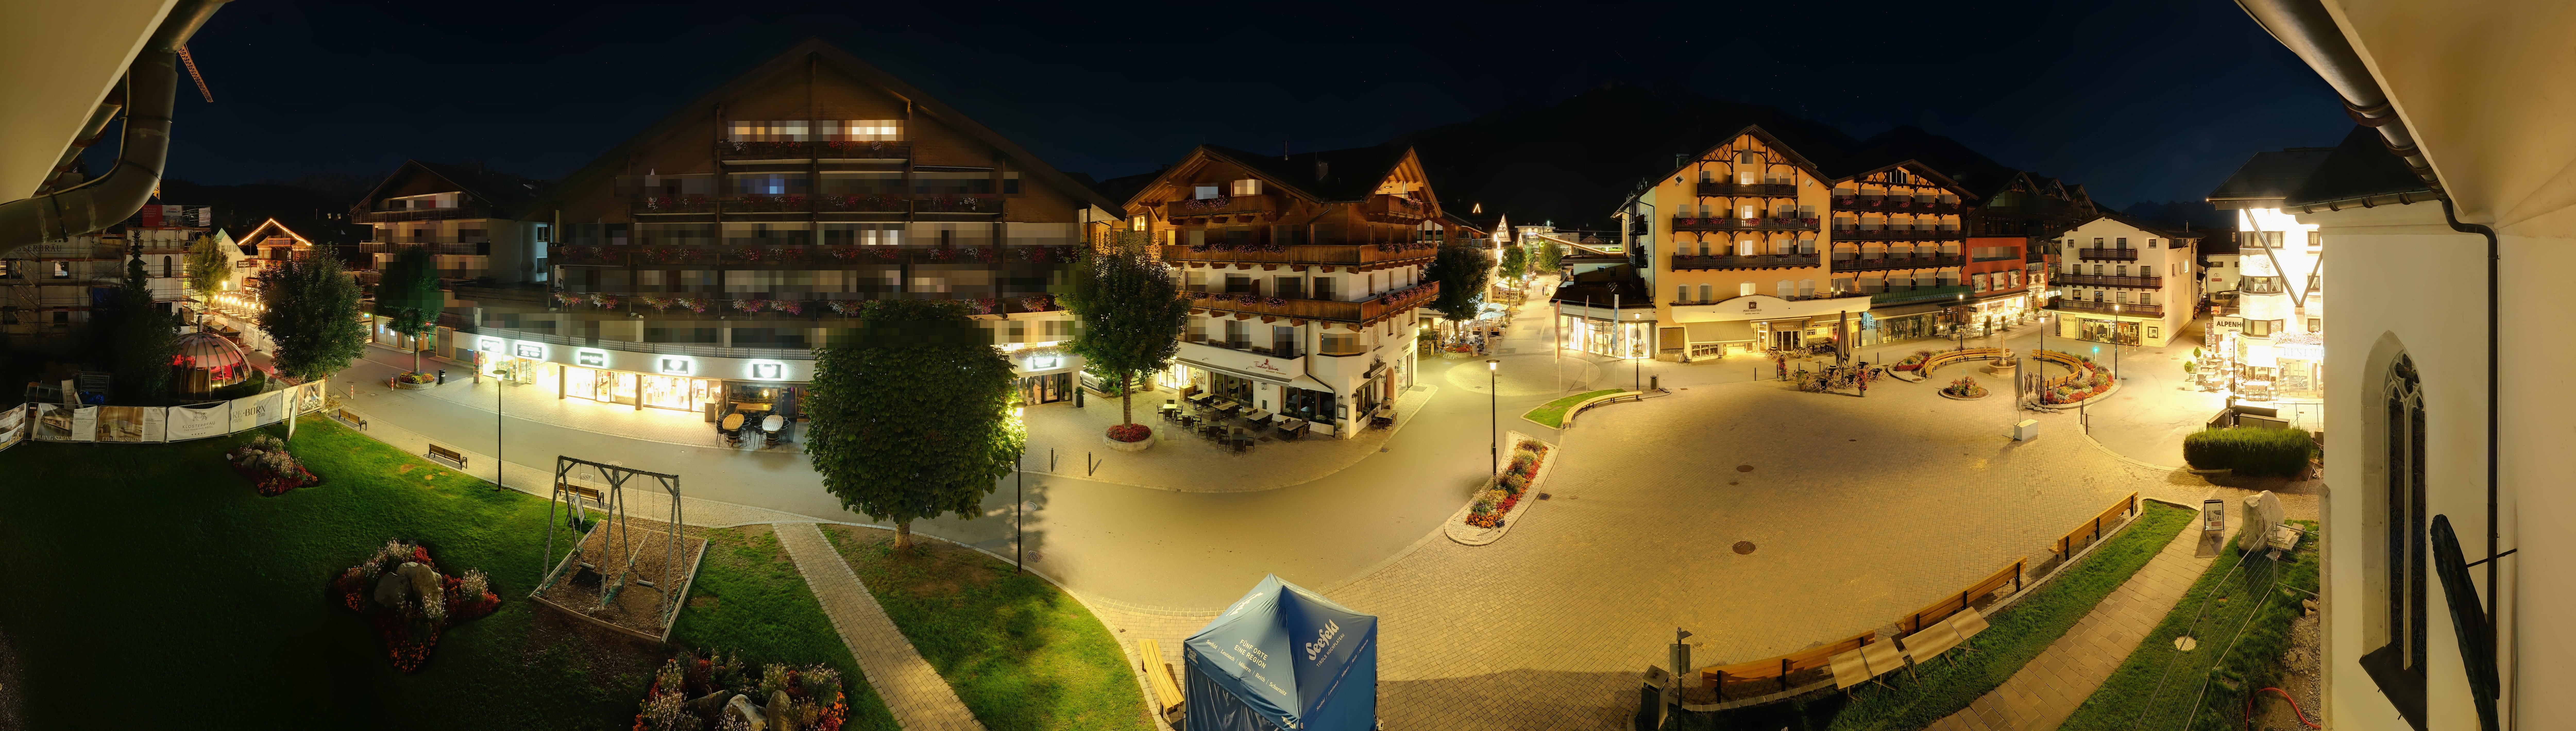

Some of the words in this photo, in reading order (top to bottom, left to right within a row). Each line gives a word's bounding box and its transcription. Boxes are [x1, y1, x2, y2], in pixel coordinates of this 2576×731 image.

[1402, 343, 1410, 351] SAILER
[1371, 364, 1385, 377] RESTAURANT
[1240, 639, 1253, 650] FÜNF
[1253, 648, 1268, 661] ORTE
[1306, 619, 1339, 661] Seefeld
[1316, 654, 1327, 667] TIROLS
[1326, 633, 1345, 656] HOCHPLATEAU
[1187, 647, 1197, 657] #tirols
[1188, 654, 1198, 664] plateau
[1234, 644, 1246, 655] EINE
[1246, 652, 1266, 669] REGION
[1206, 639, 1218, 650] Seefeld
[1220, 649, 1235, 661] Leutasch
[1238, 661, 1251, 673] Mösern
[1255, 672, 1265, 683] Reith
[1269, 682, 1287, 696] Scharnitz
[1316, 697, 1325, 712] Seefeld
[1328, 680, 1339, 696] Leutasch
[1359, 639, 1368, 653] Scharnitz
